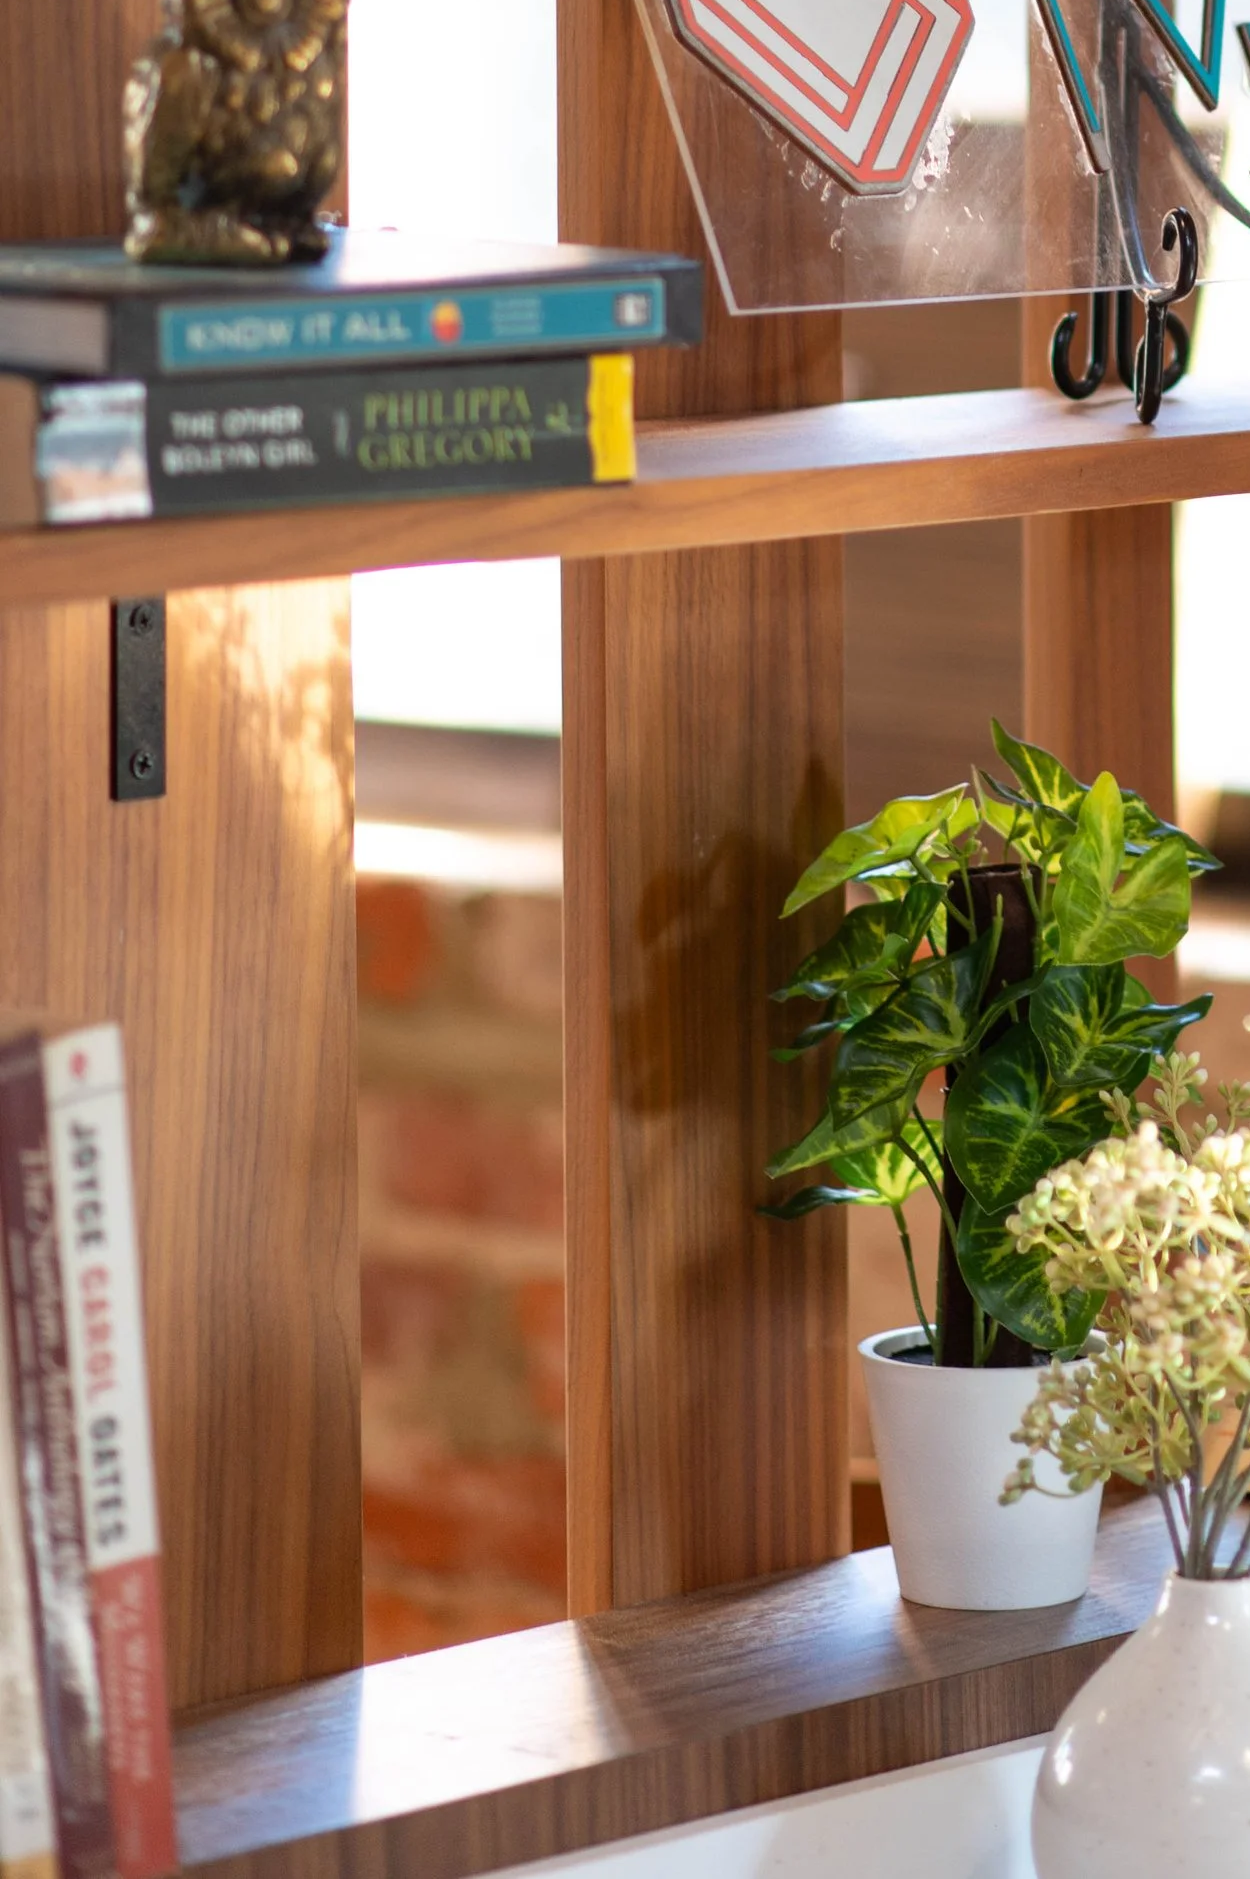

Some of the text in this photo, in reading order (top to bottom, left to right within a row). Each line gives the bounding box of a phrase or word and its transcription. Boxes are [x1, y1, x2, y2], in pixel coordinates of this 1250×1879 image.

[185, 310, 411, 353] KNOW IT ALL
[171, 405, 304, 440] THE OTHER
[364, 386, 531, 431] PHILIPPA
[262, 438, 318, 470] GIRL
[357, 427, 535, 471] GREGORY
[68, 1120, 129, 1550] JOYCE CAROL OATES
